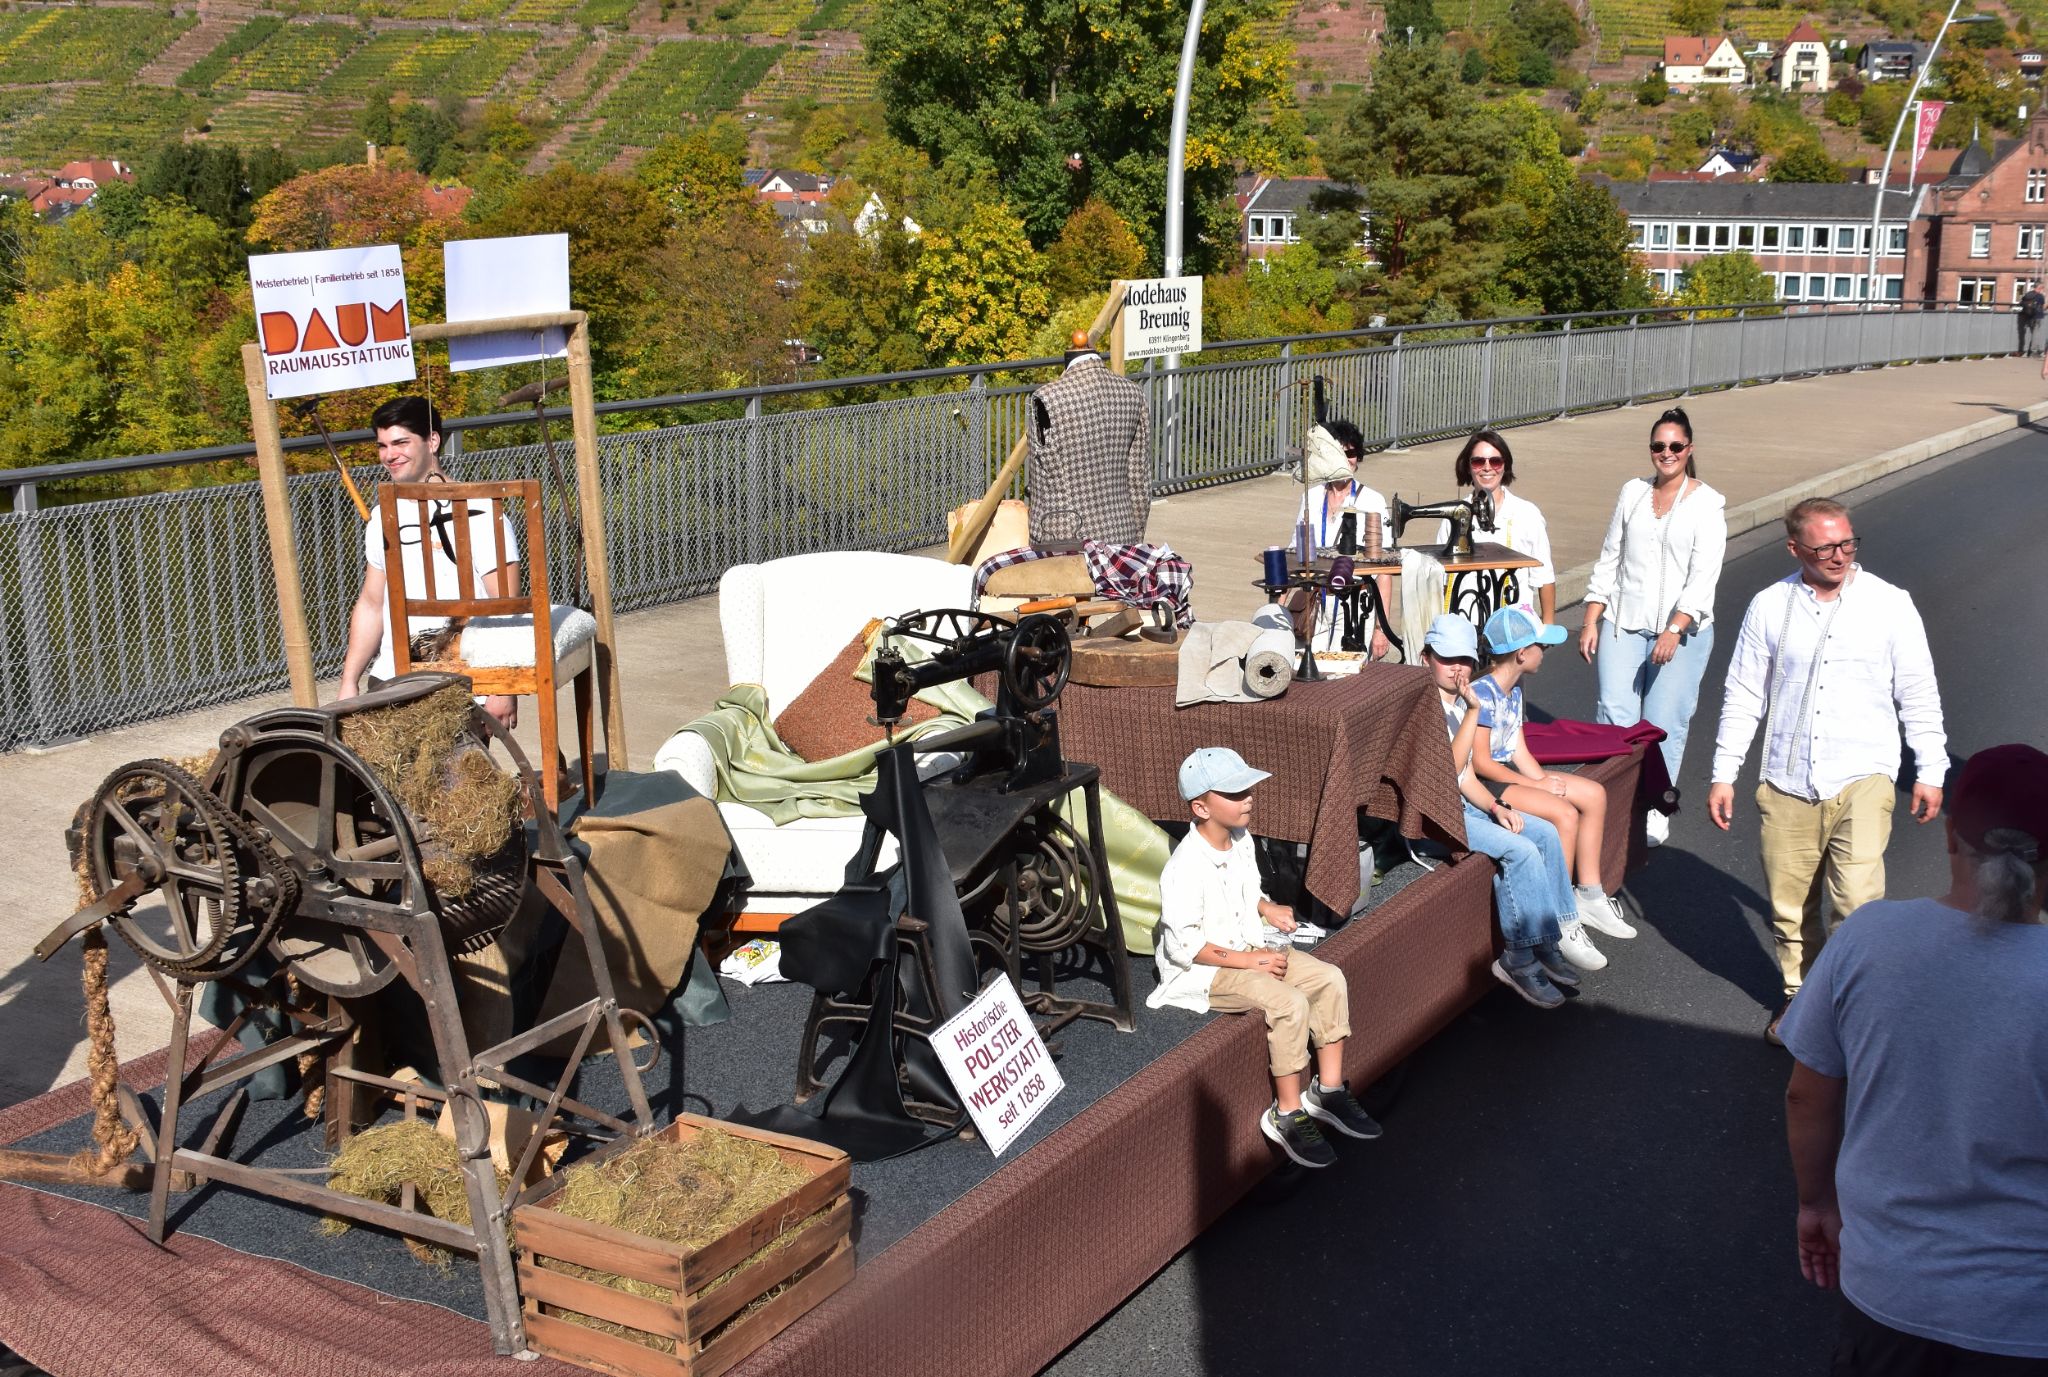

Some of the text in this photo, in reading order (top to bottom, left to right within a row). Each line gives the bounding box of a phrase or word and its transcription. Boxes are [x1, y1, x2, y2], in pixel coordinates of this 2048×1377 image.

[256, 268, 401, 289] Meisterbetrieb Familienbetrieb seit 1858
[260, 299, 407, 356] DAUM
[1139, 305, 1190, 332] Breunig
[1148, 333, 1190, 344] 63911 Klingenberg
[269, 344, 410, 375] RAUMAUSSTATTUNG
[1128, 344, 1190, 357] www.modehaus-breunig.de
[953, 1000, 1009, 1052] Historische
[964, 1018, 1023, 1080] POLSTER
[968, 1037, 1042, 1113] WERKSTATT
[998, 1073, 1046, 1130] seit 1858
